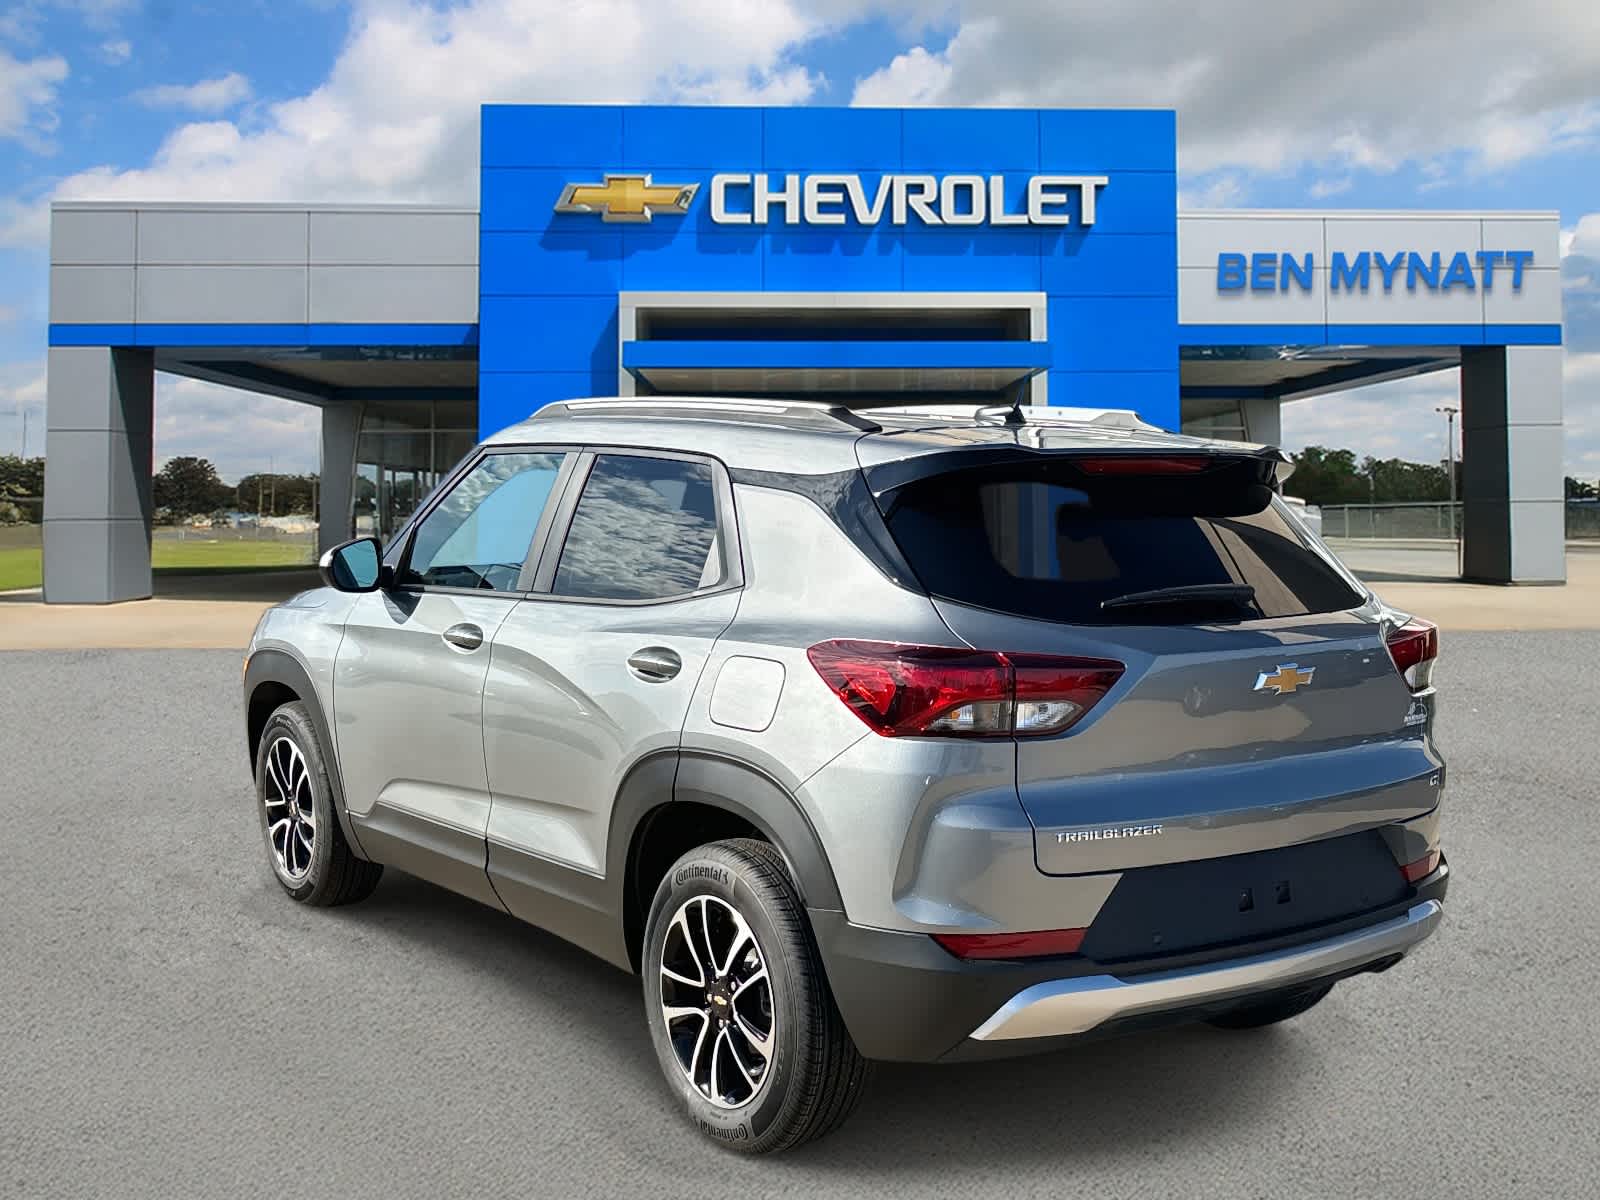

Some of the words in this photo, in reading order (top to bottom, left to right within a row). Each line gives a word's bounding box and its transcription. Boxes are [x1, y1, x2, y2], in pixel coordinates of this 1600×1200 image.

[711, 173, 1110, 225] CHEVROLET
[1216, 252, 1314, 291] BEN
[1329, 250, 1535, 290] MYNATT
[1055, 824, 1164, 844] TRAILBLAZER
[675, 864, 723, 886] Continental
